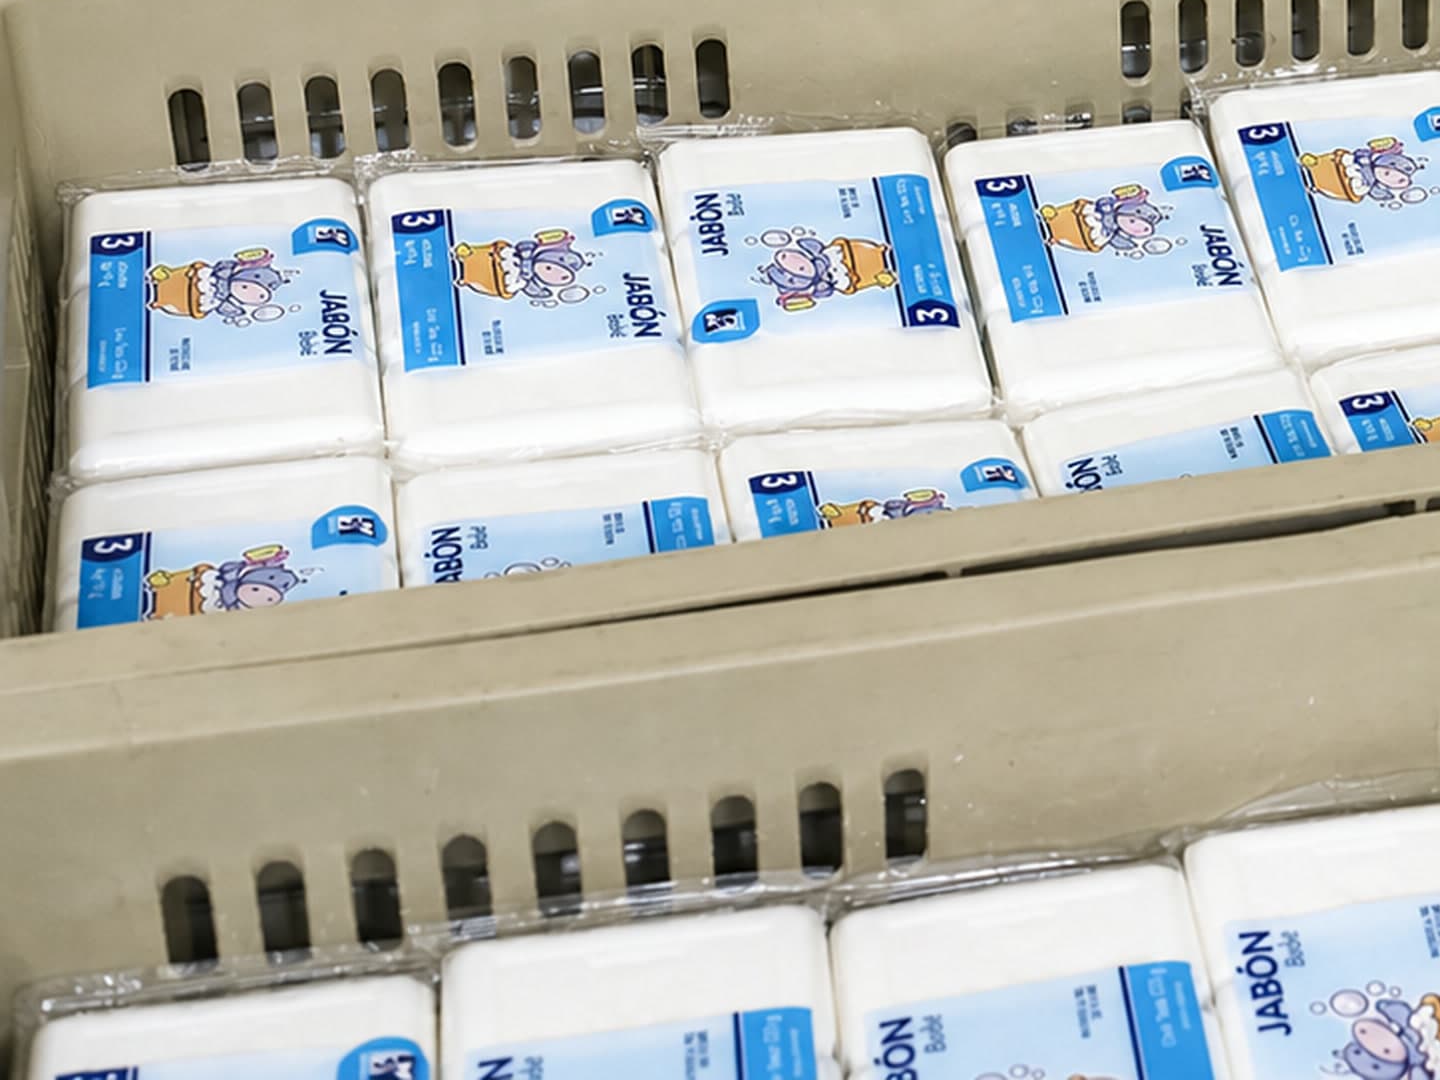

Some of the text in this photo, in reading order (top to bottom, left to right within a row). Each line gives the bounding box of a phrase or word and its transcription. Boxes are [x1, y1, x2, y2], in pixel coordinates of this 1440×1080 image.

[1248, 126, 1279, 140] 3
[983, 178, 1015, 191] 3
[402, 213, 436, 227] 3
[690, 194, 728, 255] JABÓN
[100, 235, 135, 249] 3
[1200, 225, 1245, 286] JABÓN
[622, 272, 666, 337] JABÓN
[320, 290, 358, 354] JABÓN
[915, 308, 950, 322] 3
[1352, 395, 1384, 410] 3
[760, 474, 797, 489] 3
[94, 537, 133, 554] 3
[424, 526, 463, 583] ABÓN
[1235, 930, 1292, 1036] JABÓN
